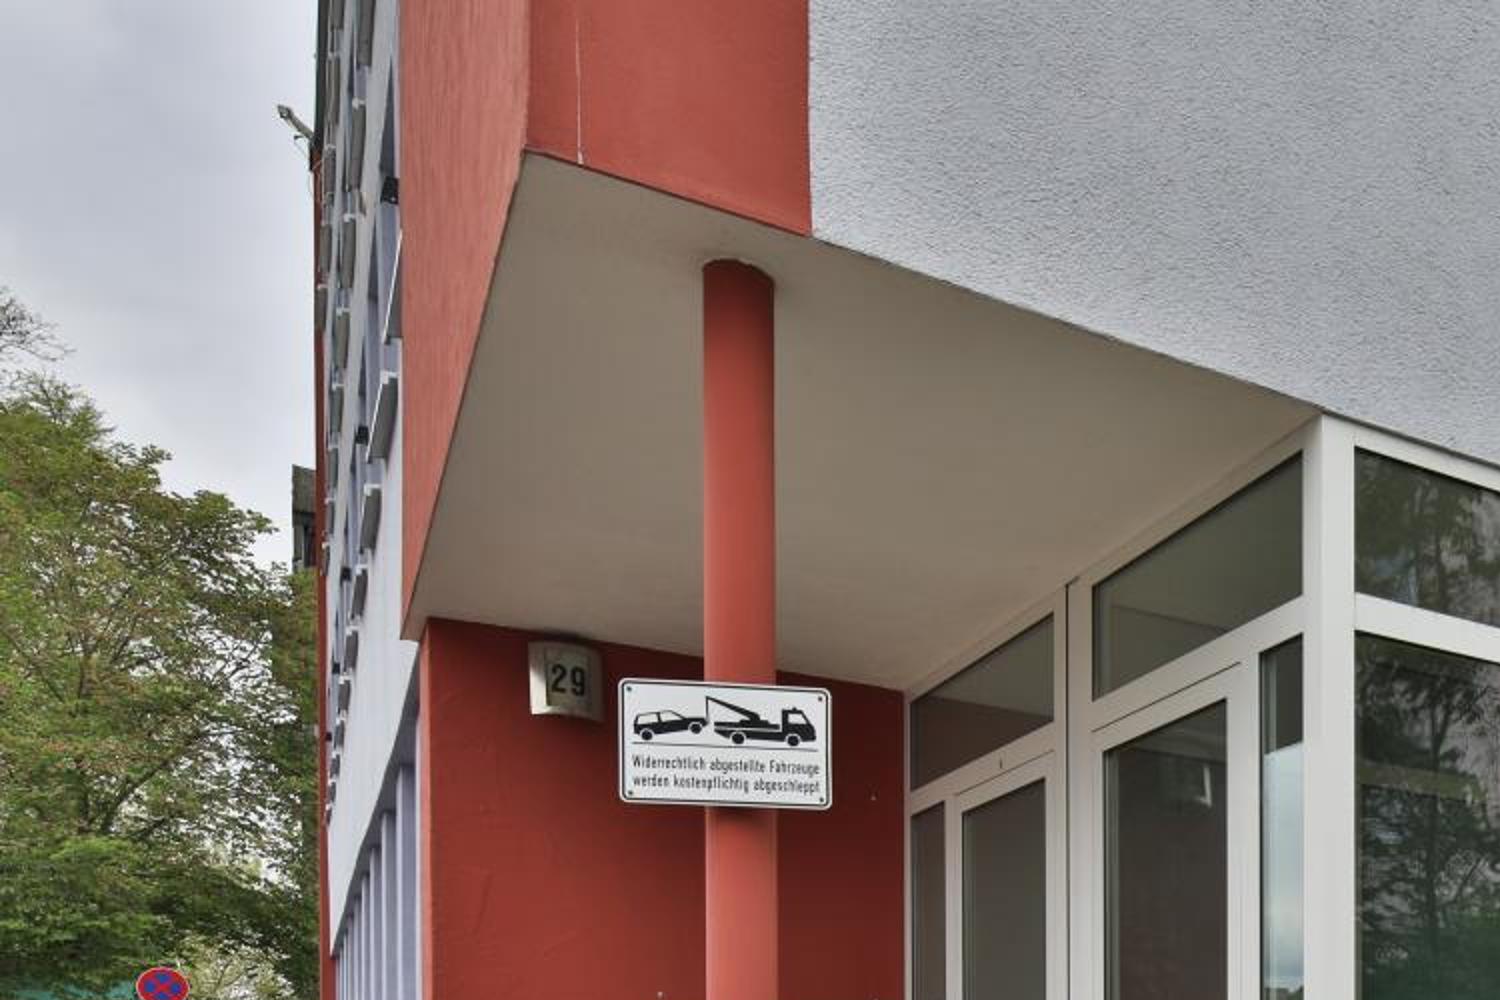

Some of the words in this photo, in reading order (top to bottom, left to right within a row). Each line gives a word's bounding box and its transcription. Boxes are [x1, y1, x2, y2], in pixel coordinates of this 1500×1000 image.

[550, 664, 585, 697] 29
[632, 755, 706, 770] Widerrechtlich
[710, 758, 766, 775] abgestellte
[769, 760, 820, 778] Fahrzeuge
[633, 774, 669, 787] werden
[673, 774, 749, 794] kostenpflichtig
[753, 778, 820, 796] abgeschleppt
